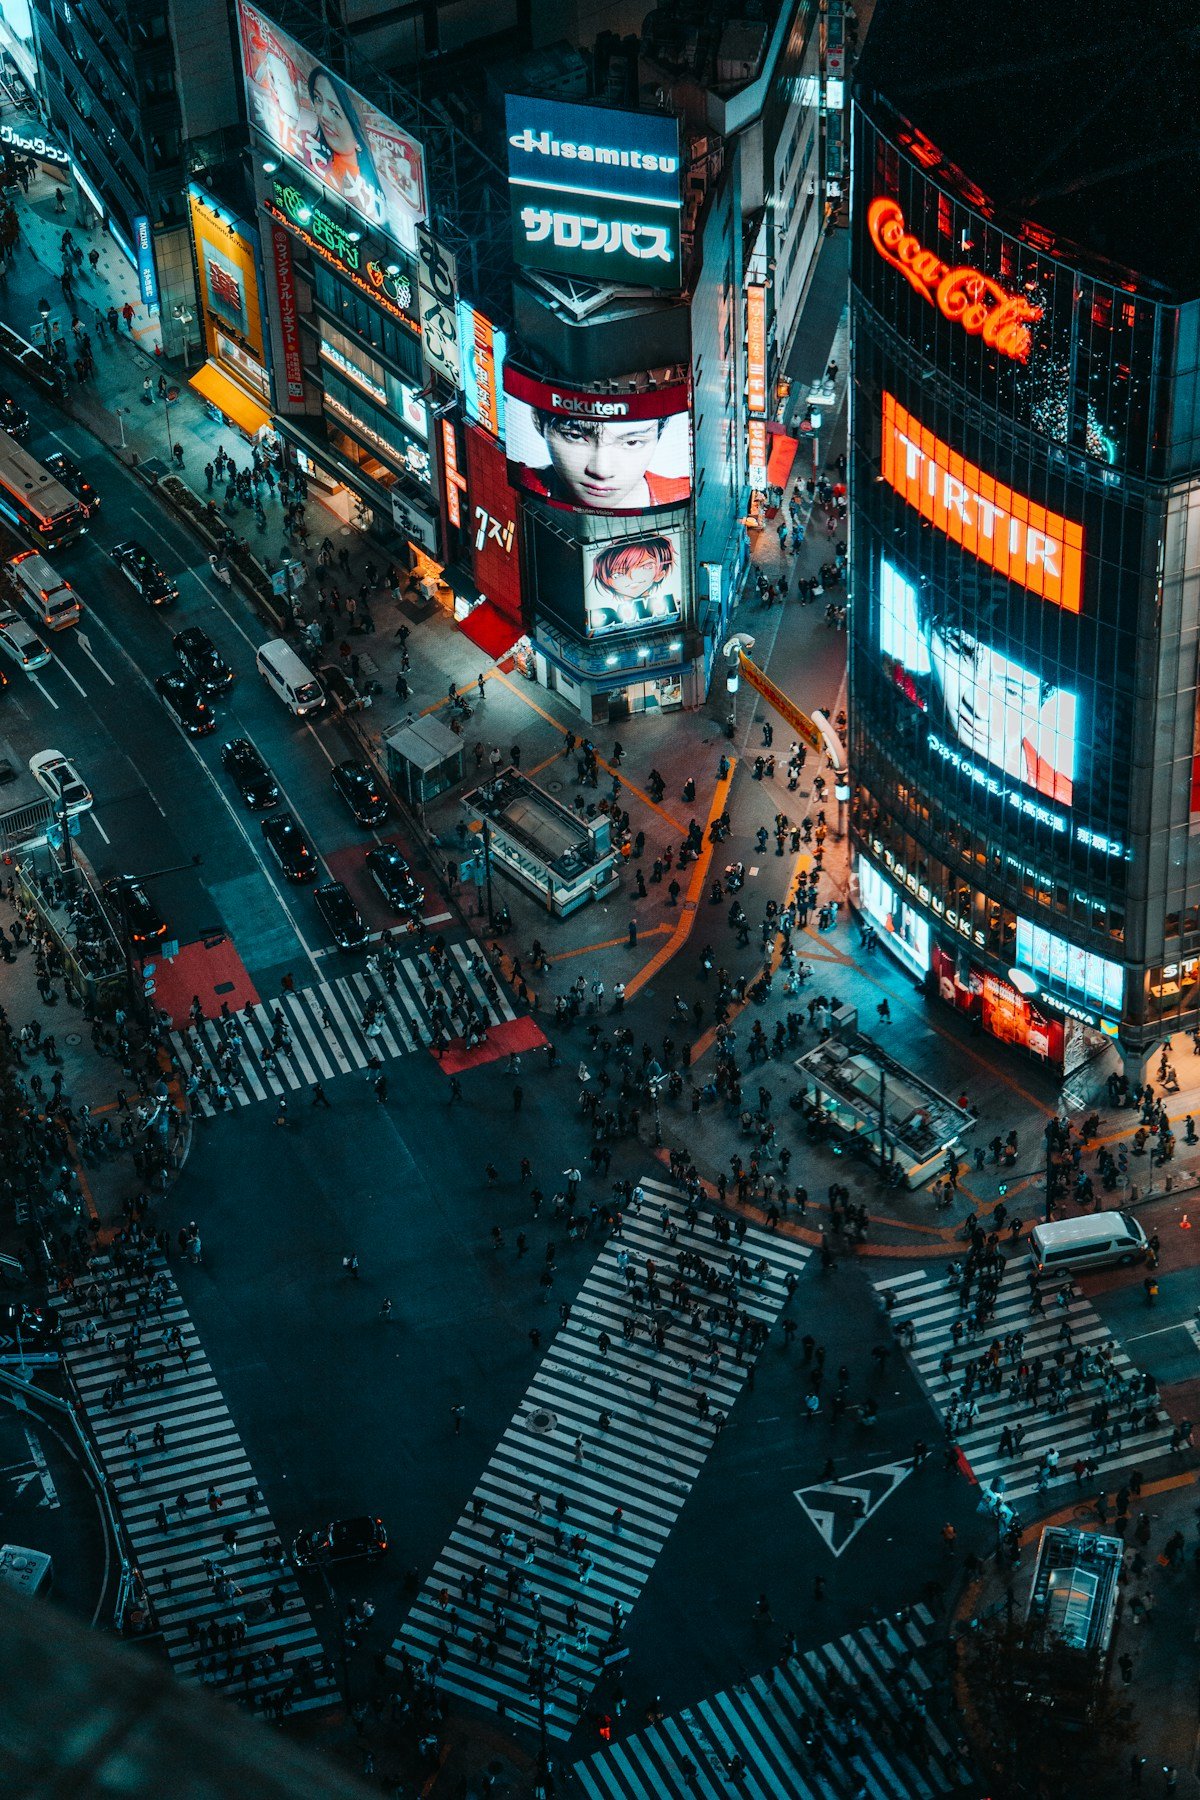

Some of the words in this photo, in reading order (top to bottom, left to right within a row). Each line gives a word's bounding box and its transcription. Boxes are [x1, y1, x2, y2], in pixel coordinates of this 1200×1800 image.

[509, 129, 678, 174] Hisamitsu
[139, 222, 149, 250] MIZUHO
[520, 207, 675, 263] サロンパス
[867, 196, 1045, 365] Coca-Cola
[551, 393, 630, 417] Rakuten
[572, 505, 598, 515] Rakuten
[597, 508, 615, 517] Vision
[897, 432, 1060, 578] TIRTIR
[872, 839, 987, 946] STARBUCKS
[1040, 992, 1094, 1025] TSUTAYA
